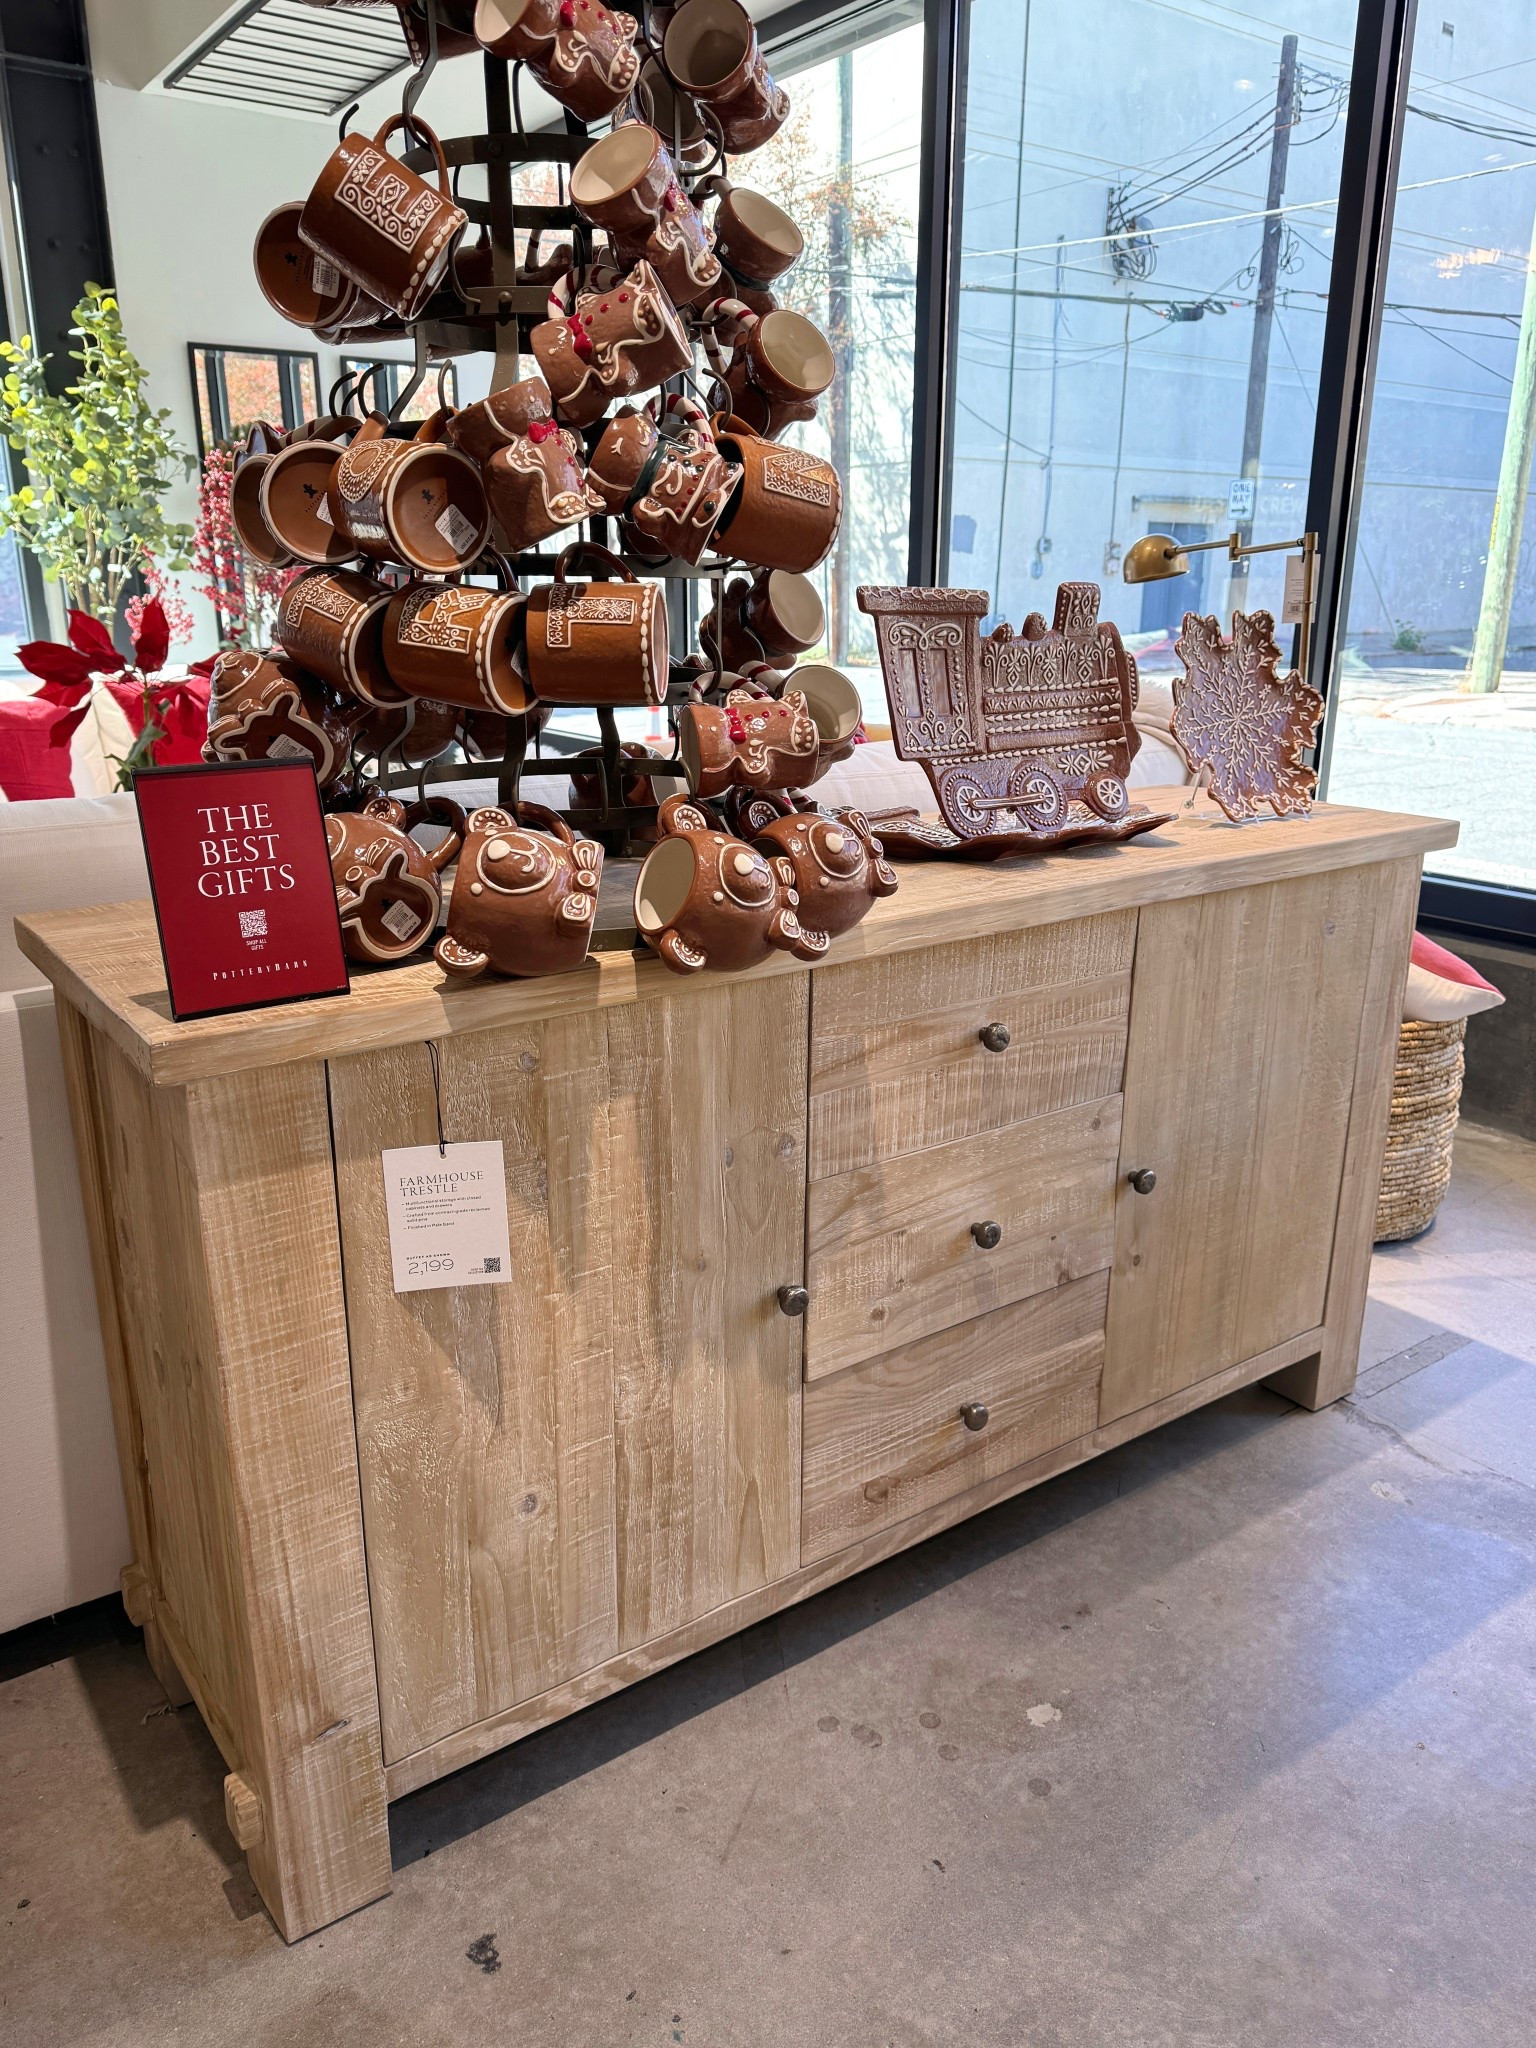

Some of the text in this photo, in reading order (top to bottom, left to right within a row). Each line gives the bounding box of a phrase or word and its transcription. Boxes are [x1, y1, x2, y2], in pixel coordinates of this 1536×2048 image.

[1232, 483, 1252, 493] ONE
[1231, 494, 1251, 503] WAY
[197, 803, 273, 834] THE
[199, 833, 280, 867] BEST
[197, 863, 295, 898] GIFTS
[400, 1170, 484, 1187] FARMHOUSE
[400, 1183, 458, 1197] TRESTLE
[408, 1258, 454, 1276] 2,199
